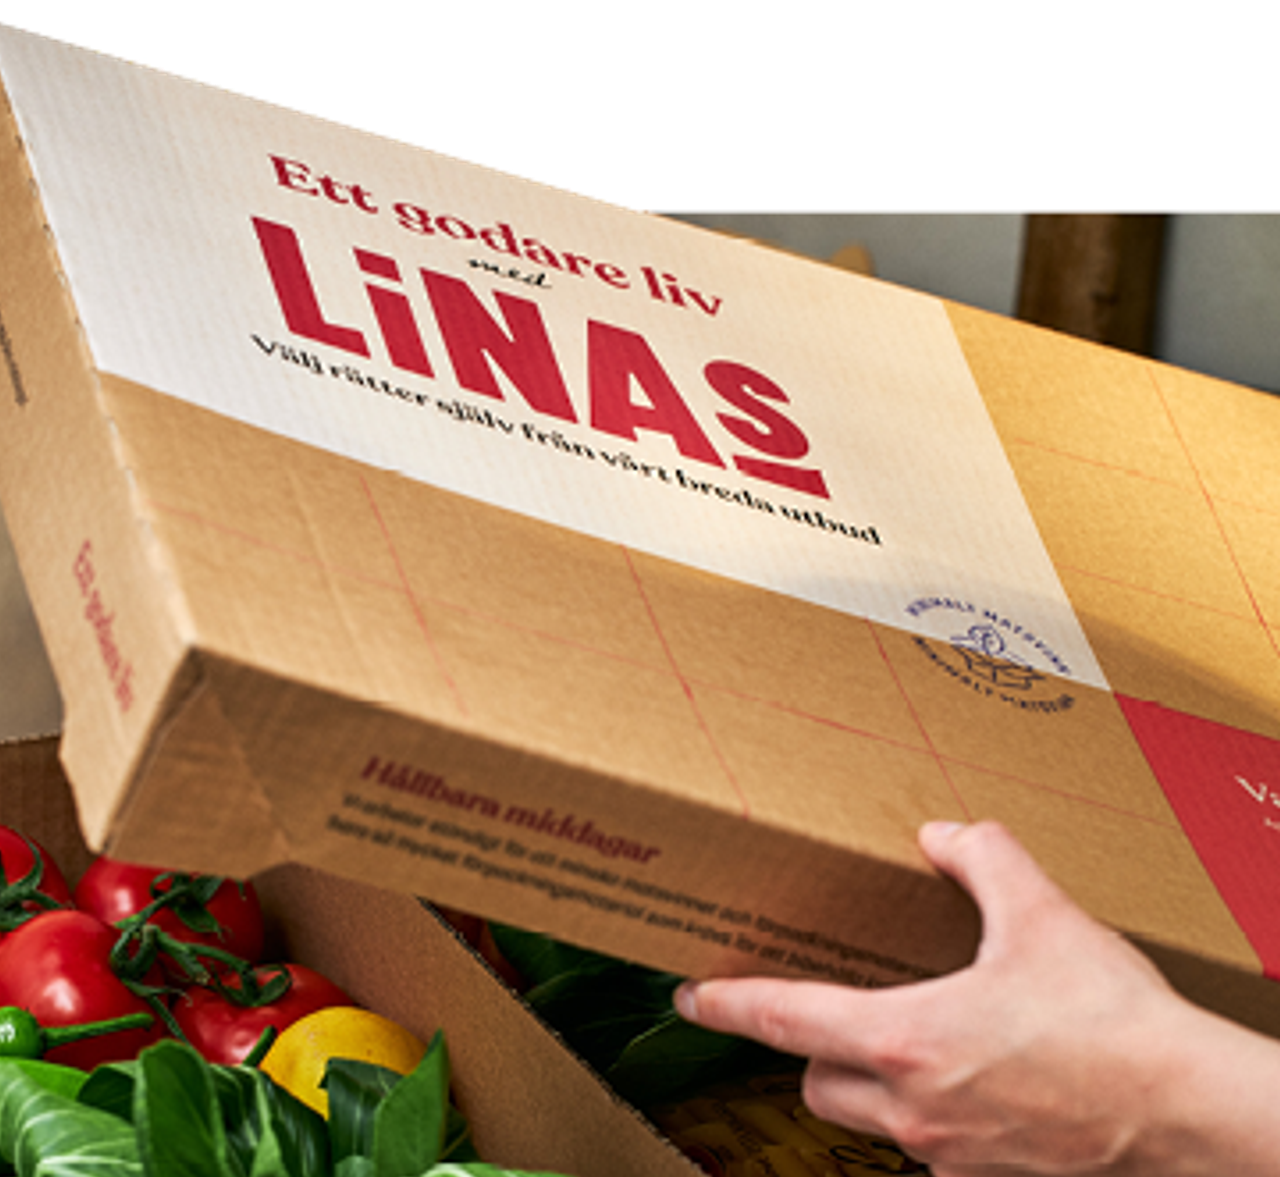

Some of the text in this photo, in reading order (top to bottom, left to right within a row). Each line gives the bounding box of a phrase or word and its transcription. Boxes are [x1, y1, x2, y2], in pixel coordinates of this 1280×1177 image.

[268, 154, 723, 316] Ett godare liv
[467, 258, 552, 289] med
[252, 335, 882, 545] Välj rätter själv från vårt breda utbud
[360, 756, 661, 864] Hållbara middagar
